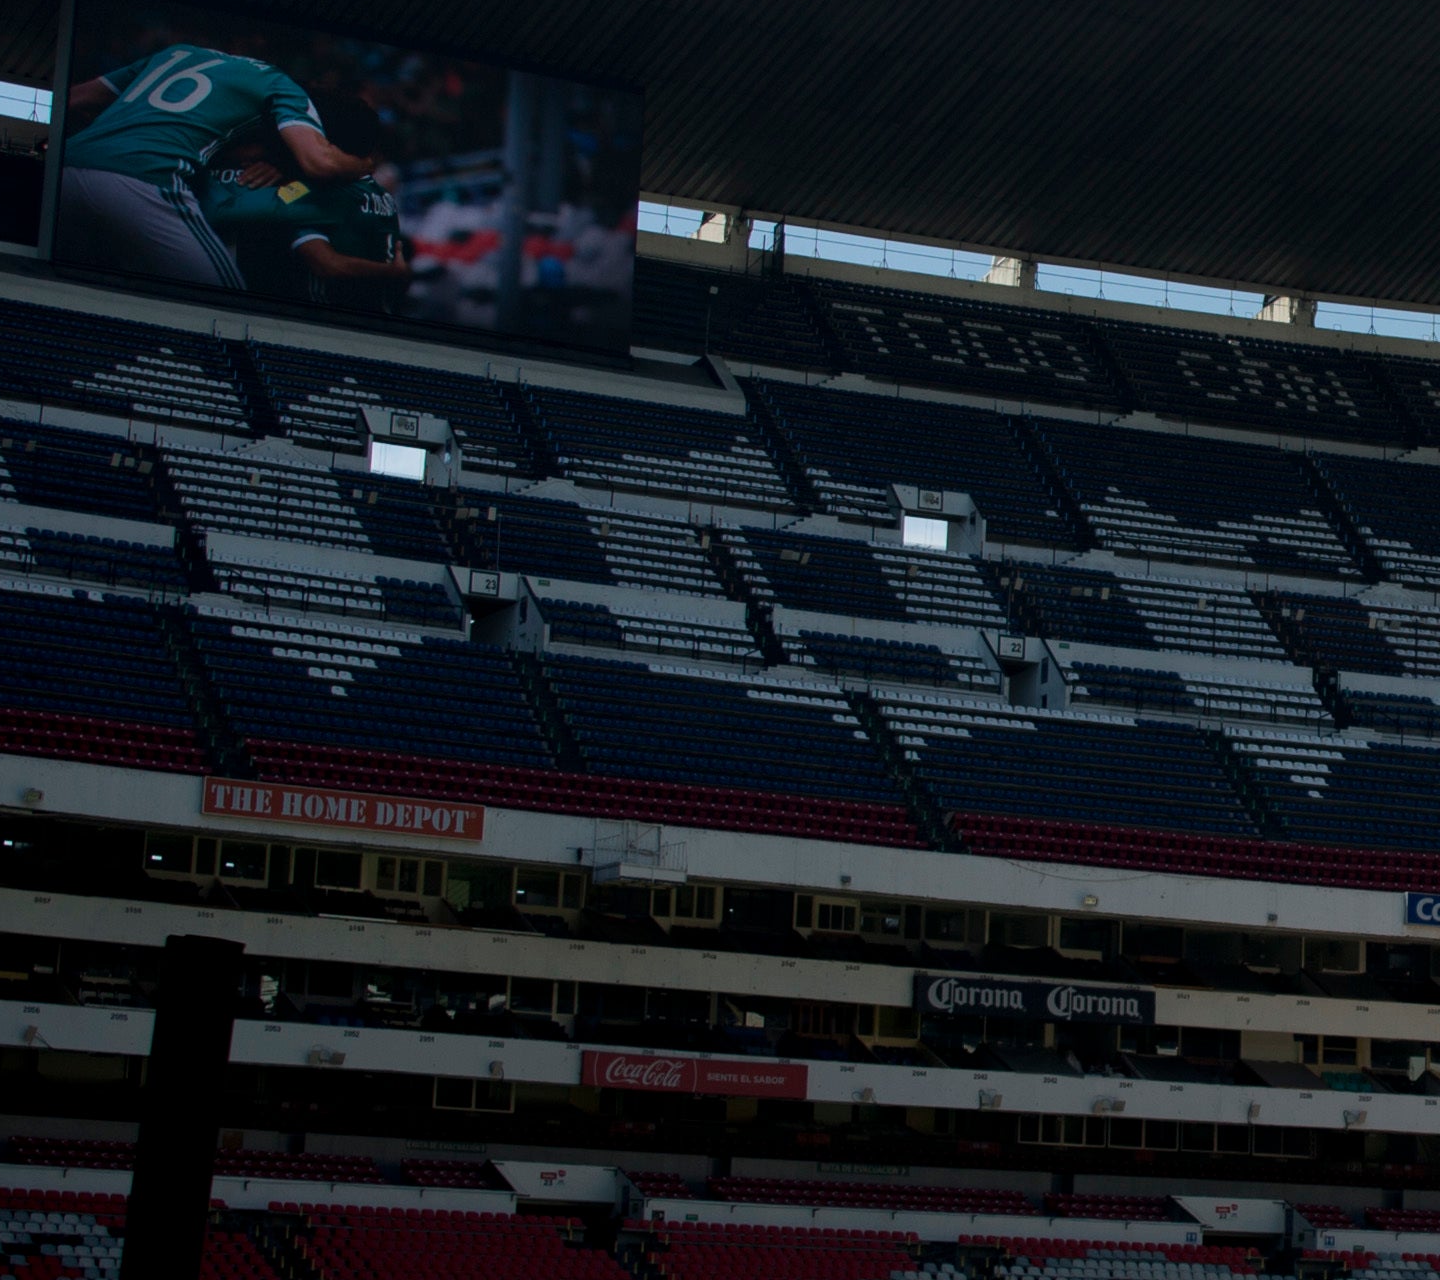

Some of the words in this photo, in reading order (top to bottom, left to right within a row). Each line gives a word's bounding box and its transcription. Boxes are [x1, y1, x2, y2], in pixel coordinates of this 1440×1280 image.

[123, 49, 228, 114] 16
[485, 580, 497, 591] 23
[1011, 644, 1022, 653] 22
[211, 782, 273, 815] THE
[281, 790, 368, 824] HOME
[375, 801, 470, 835] DEPOT
[927, 978, 1027, 1014] Corona
[1046, 985, 1142, 1020] Corona
[343, 1030, 360, 1038] 2052
[605, 1056, 687, 1088] Coca-Cola
[706, 1072, 739, 1083] SIENTE
[740, 1074, 752, 1084] EL
[753, 1075, 785, 1085] SABOR
